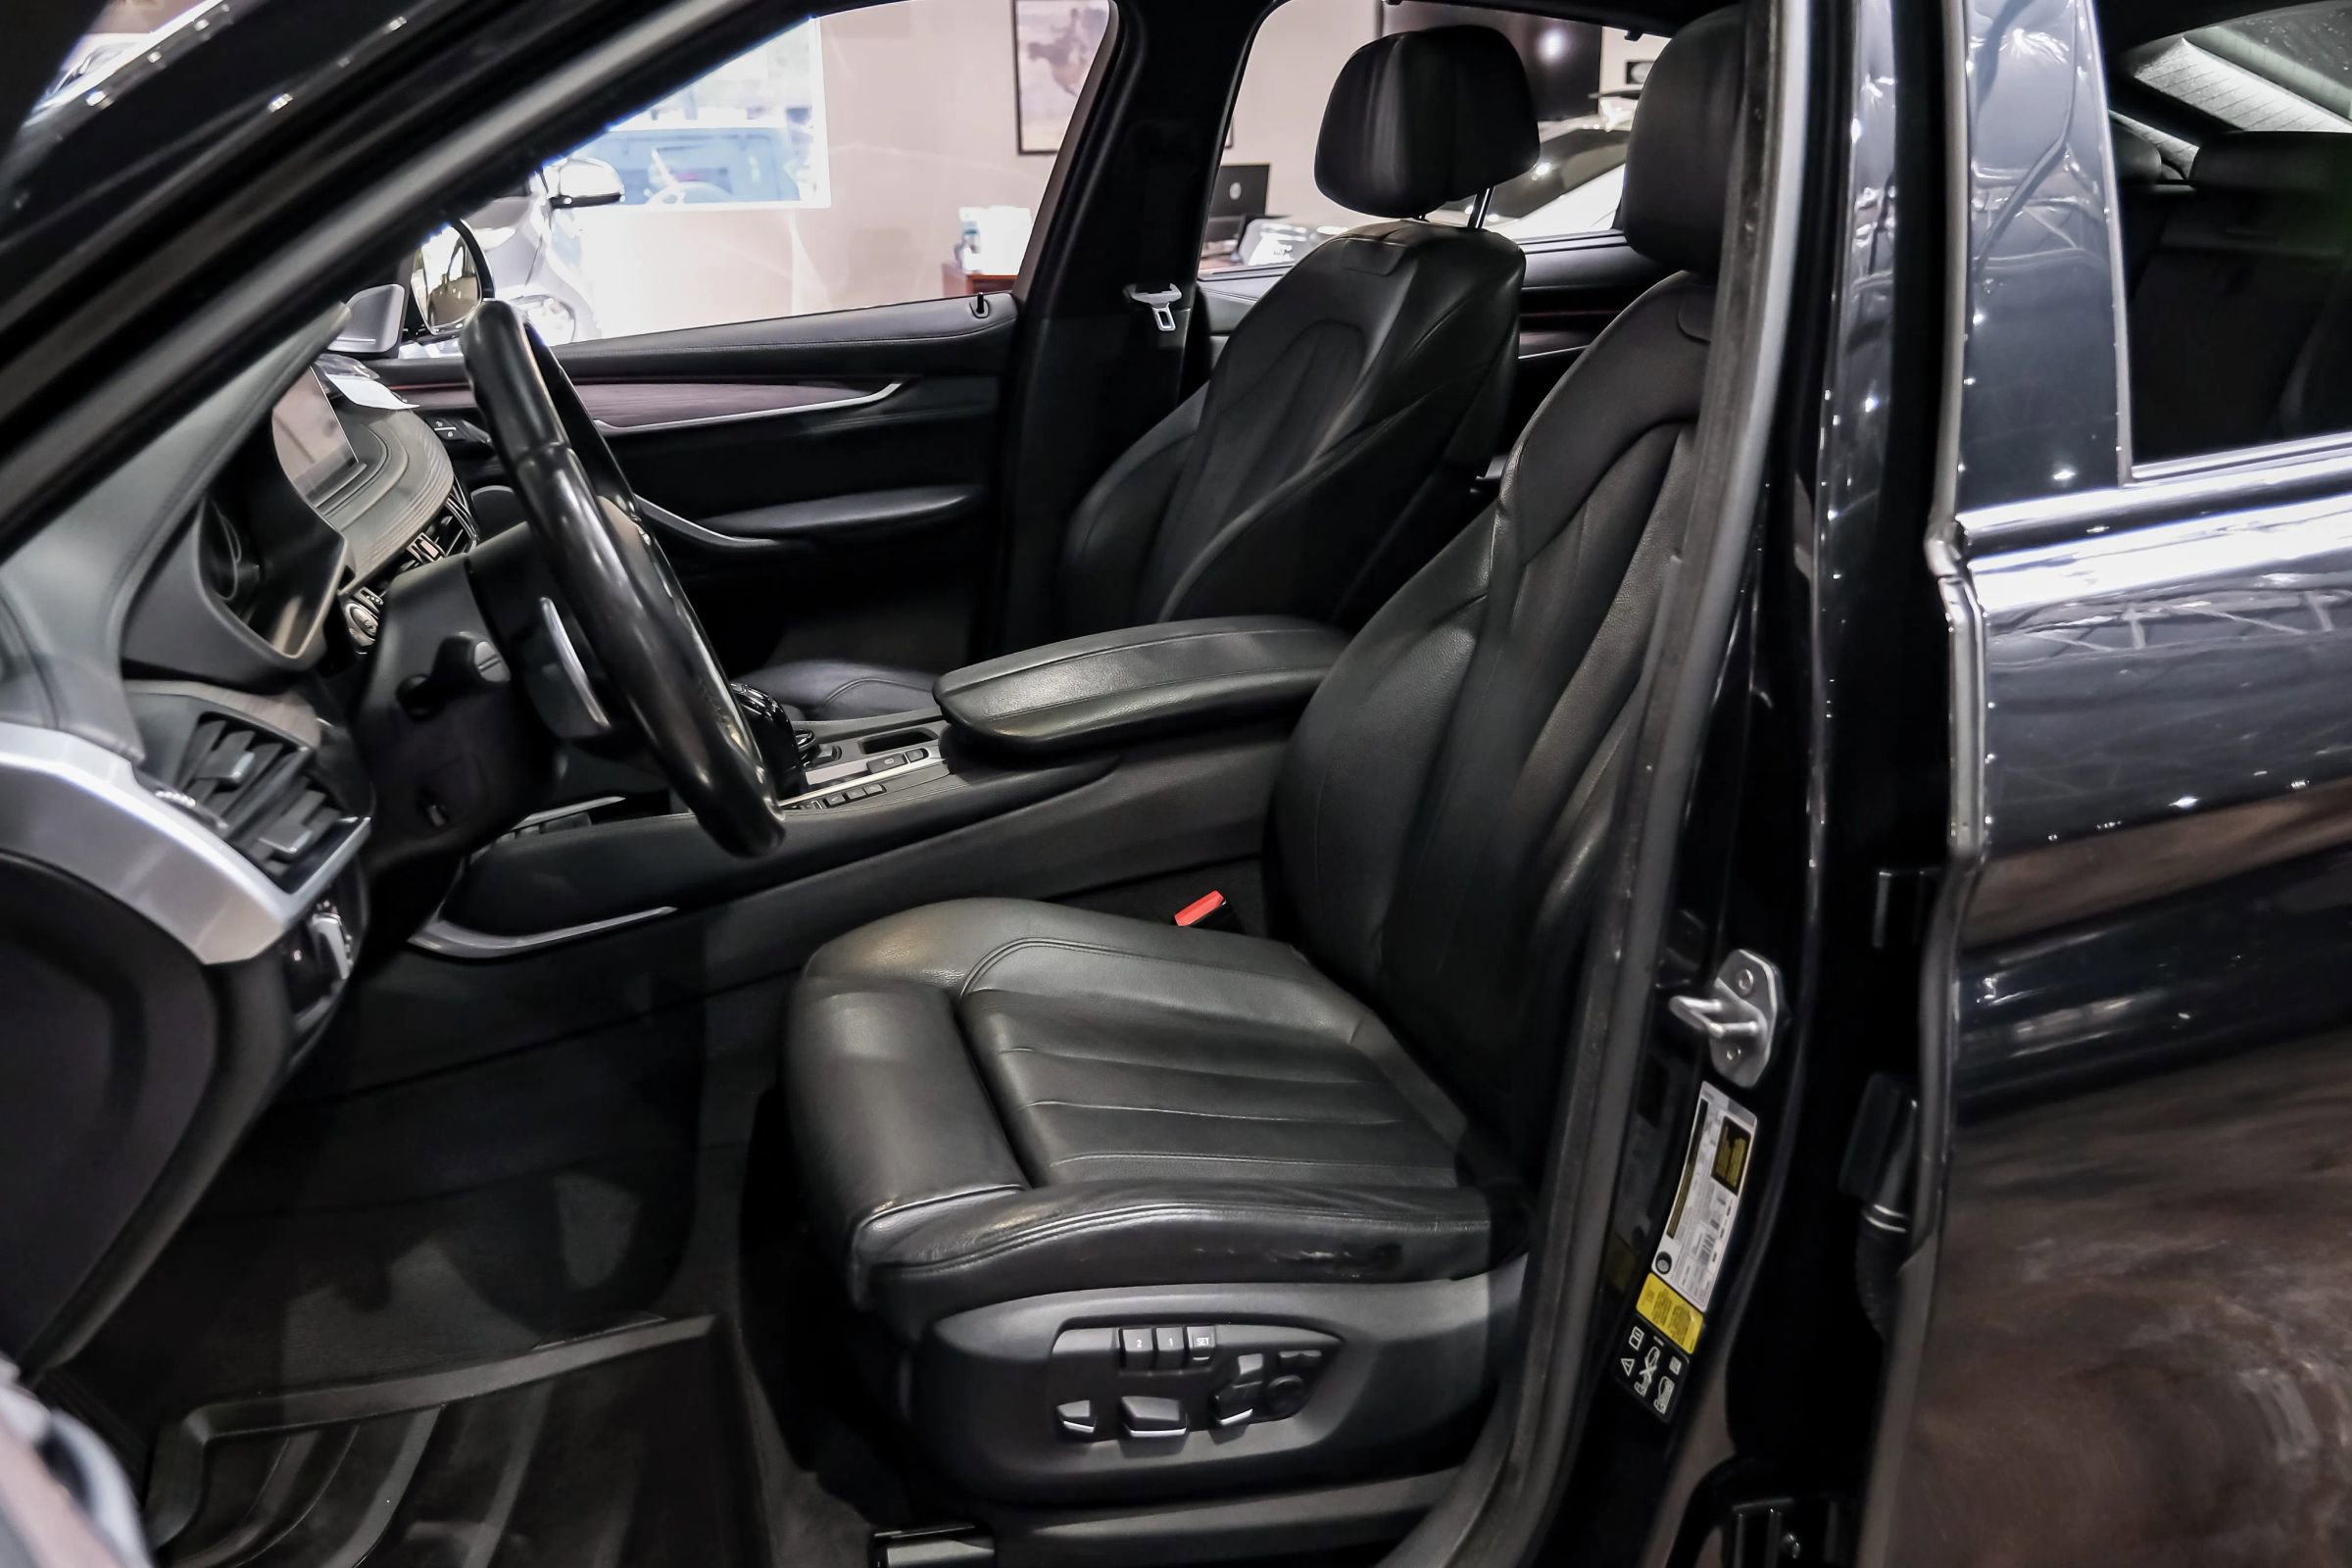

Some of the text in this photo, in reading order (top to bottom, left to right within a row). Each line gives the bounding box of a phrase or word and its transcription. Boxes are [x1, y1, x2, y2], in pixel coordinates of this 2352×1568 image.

[1136, 1339, 1143, 1348] 2
[1168, 1338, 1174, 1348] 1
[1197, 1337, 1209, 1347] SET
